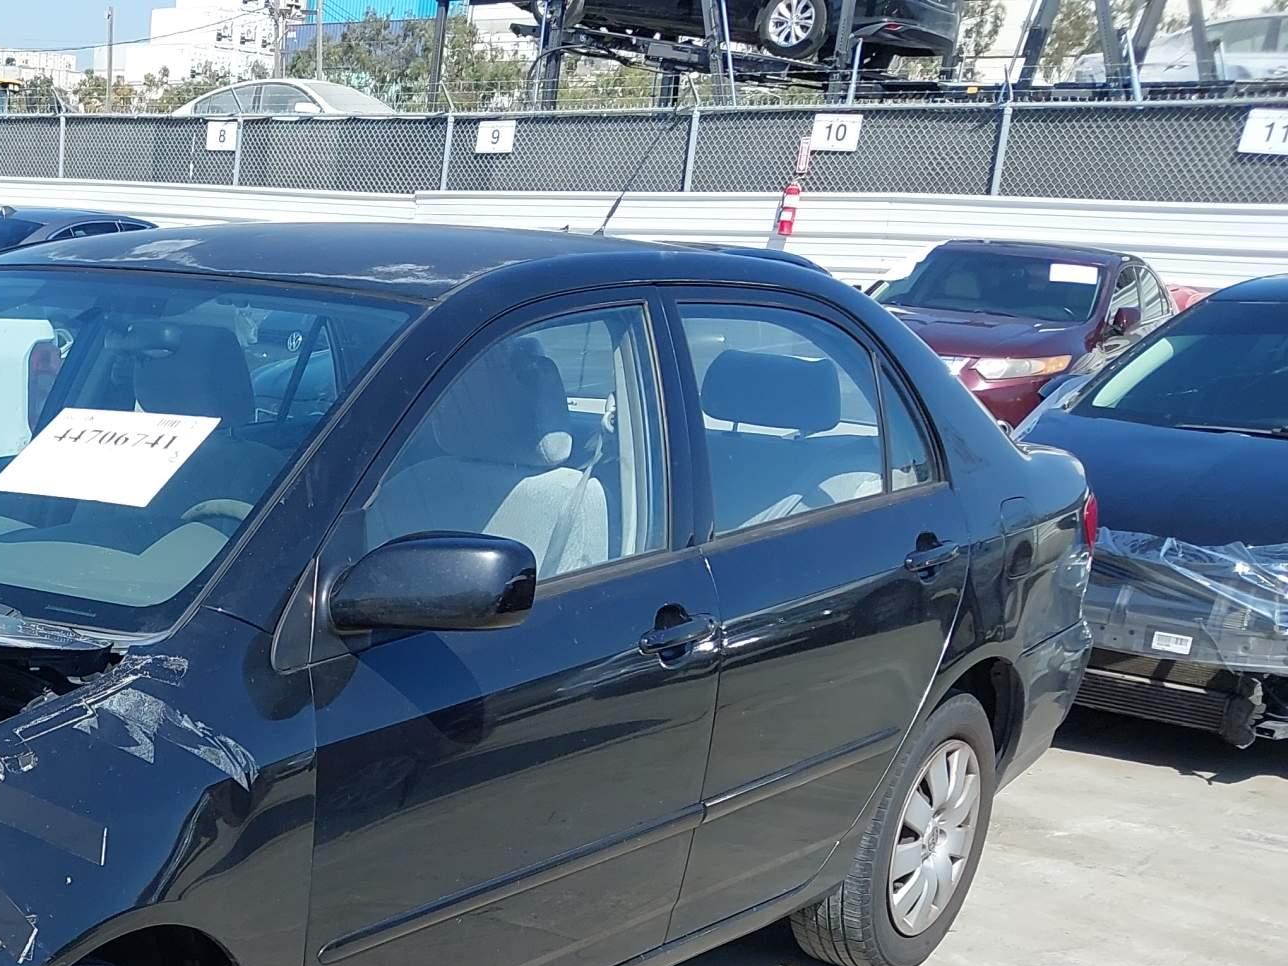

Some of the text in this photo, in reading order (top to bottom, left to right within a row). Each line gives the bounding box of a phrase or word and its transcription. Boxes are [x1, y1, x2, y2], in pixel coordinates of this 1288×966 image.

[218, 129, 226, 143] 8
[491, 129, 500, 145] 9
[825, 123, 847, 141] 10
[53, 427, 177, 450] 44706741
